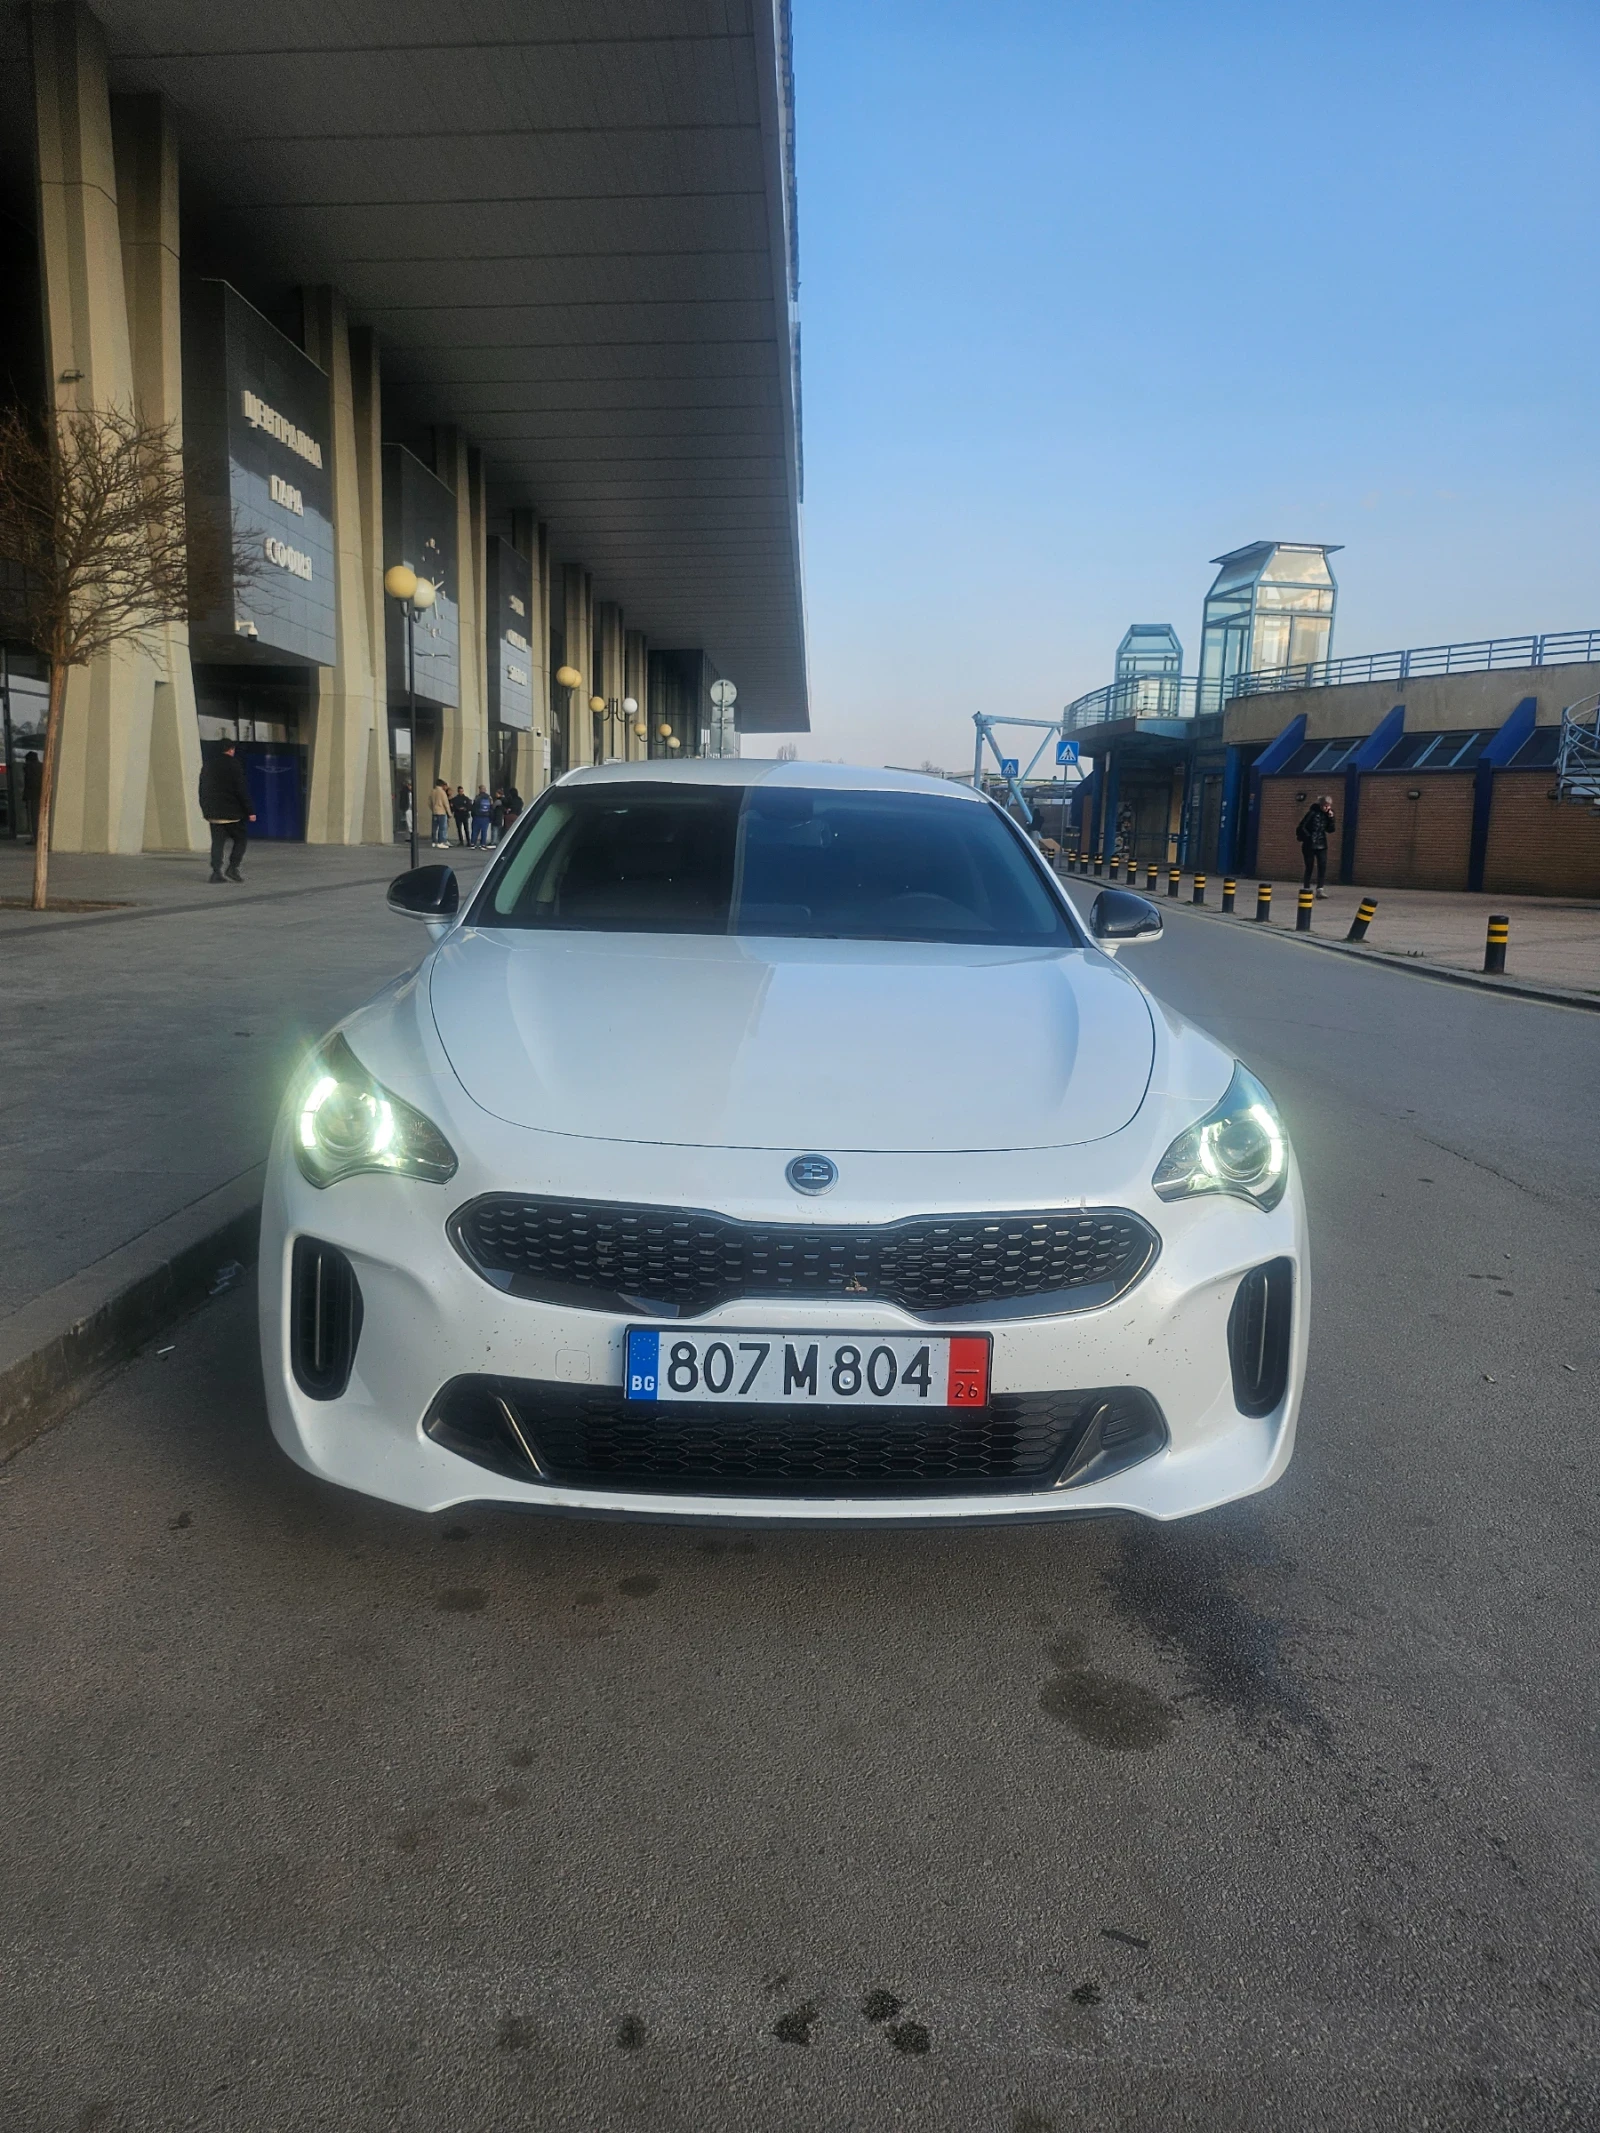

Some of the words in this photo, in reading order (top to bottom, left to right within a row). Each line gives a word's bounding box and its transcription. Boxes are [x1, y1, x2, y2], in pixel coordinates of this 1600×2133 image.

[269, 475, 304, 516] ГАРА
[264, 537, 312, 581] СОФИЯ
[631, 1375, 655, 1391] BG
[667, 1341, 772, 1394] 807
[783, 1342, 819, 1396] M
[831, 1345, 932, 1397] 804
[954, 1381, 979, 1399] 26
